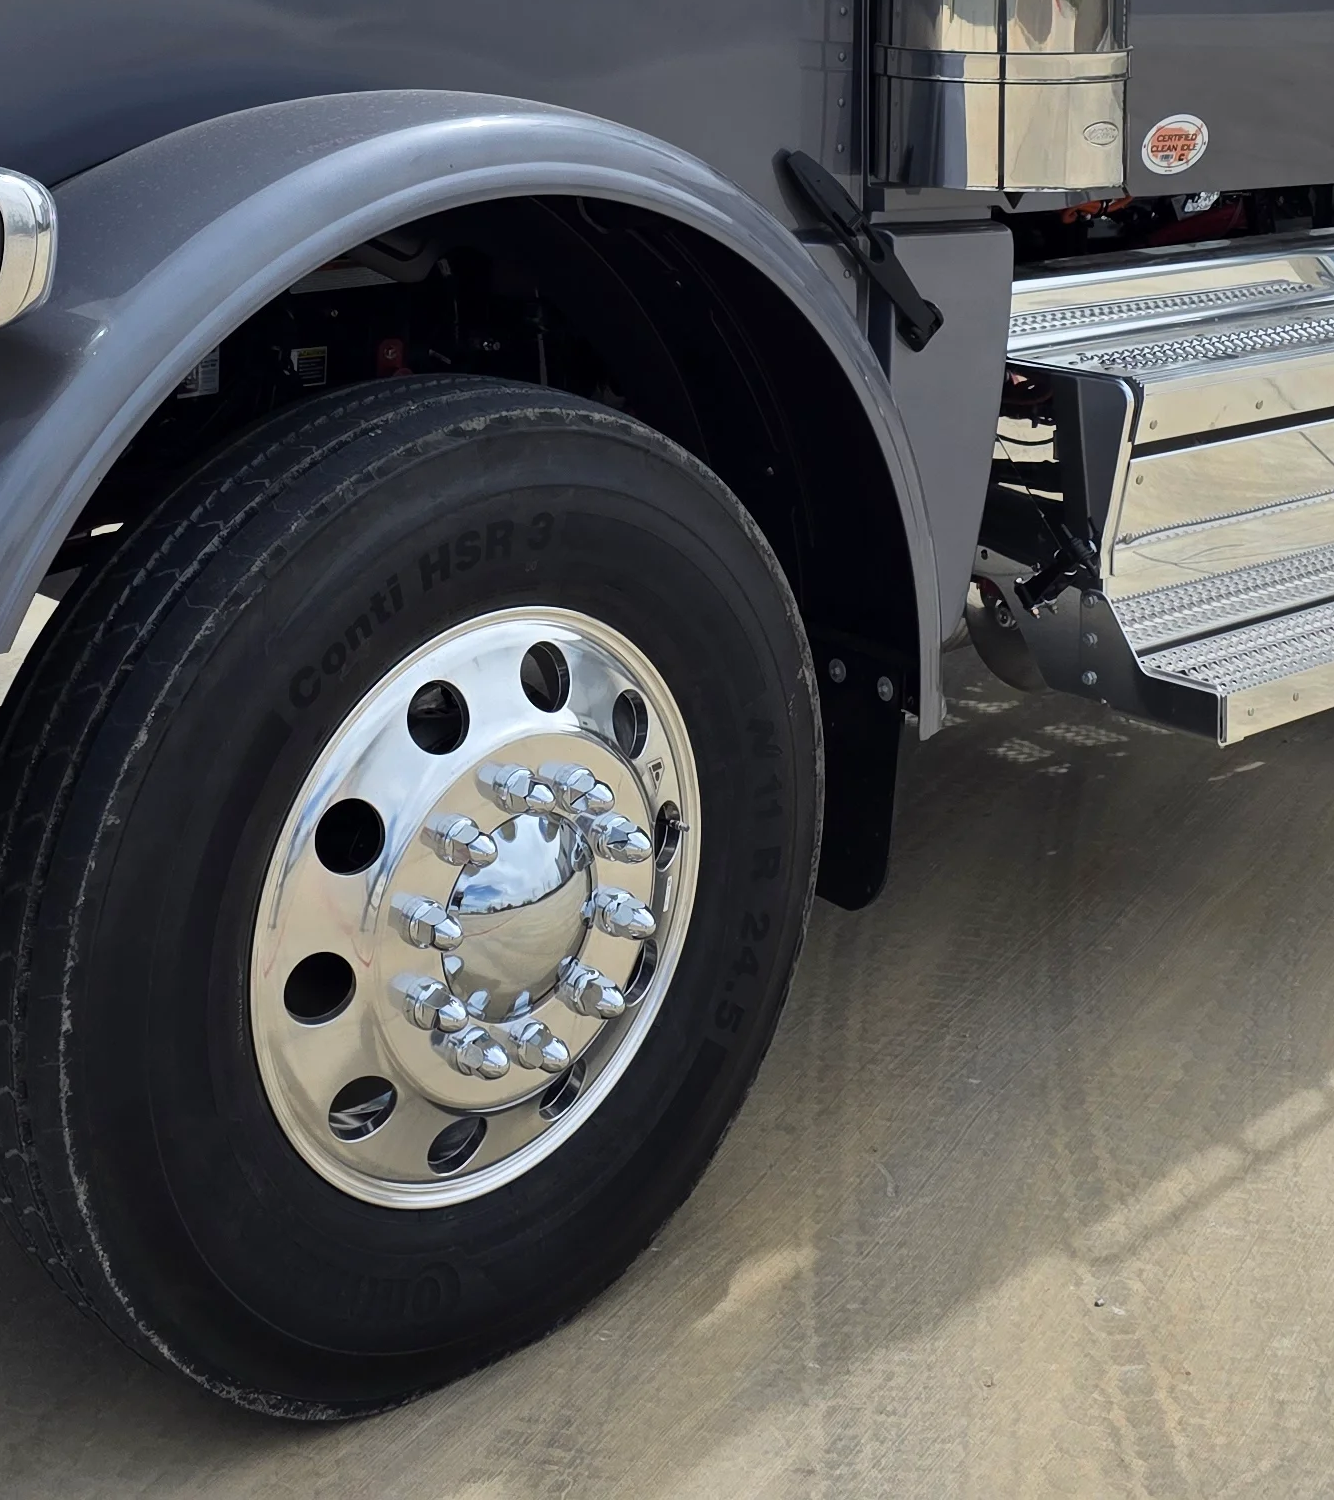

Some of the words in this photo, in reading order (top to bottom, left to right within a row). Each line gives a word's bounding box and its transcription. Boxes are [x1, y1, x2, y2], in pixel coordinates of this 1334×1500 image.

[1151, 144, 1178, 153] CLEAN
[1180, 143, 1198, 152] IDLE
[1157, 133, 1198, 143] CERTIFIED
[288, 573, 405, 709] Conti
[418, 519, 515, 592] HSR
[527, 511, 555, 551] 3
[751, 845, 782, 883] R
